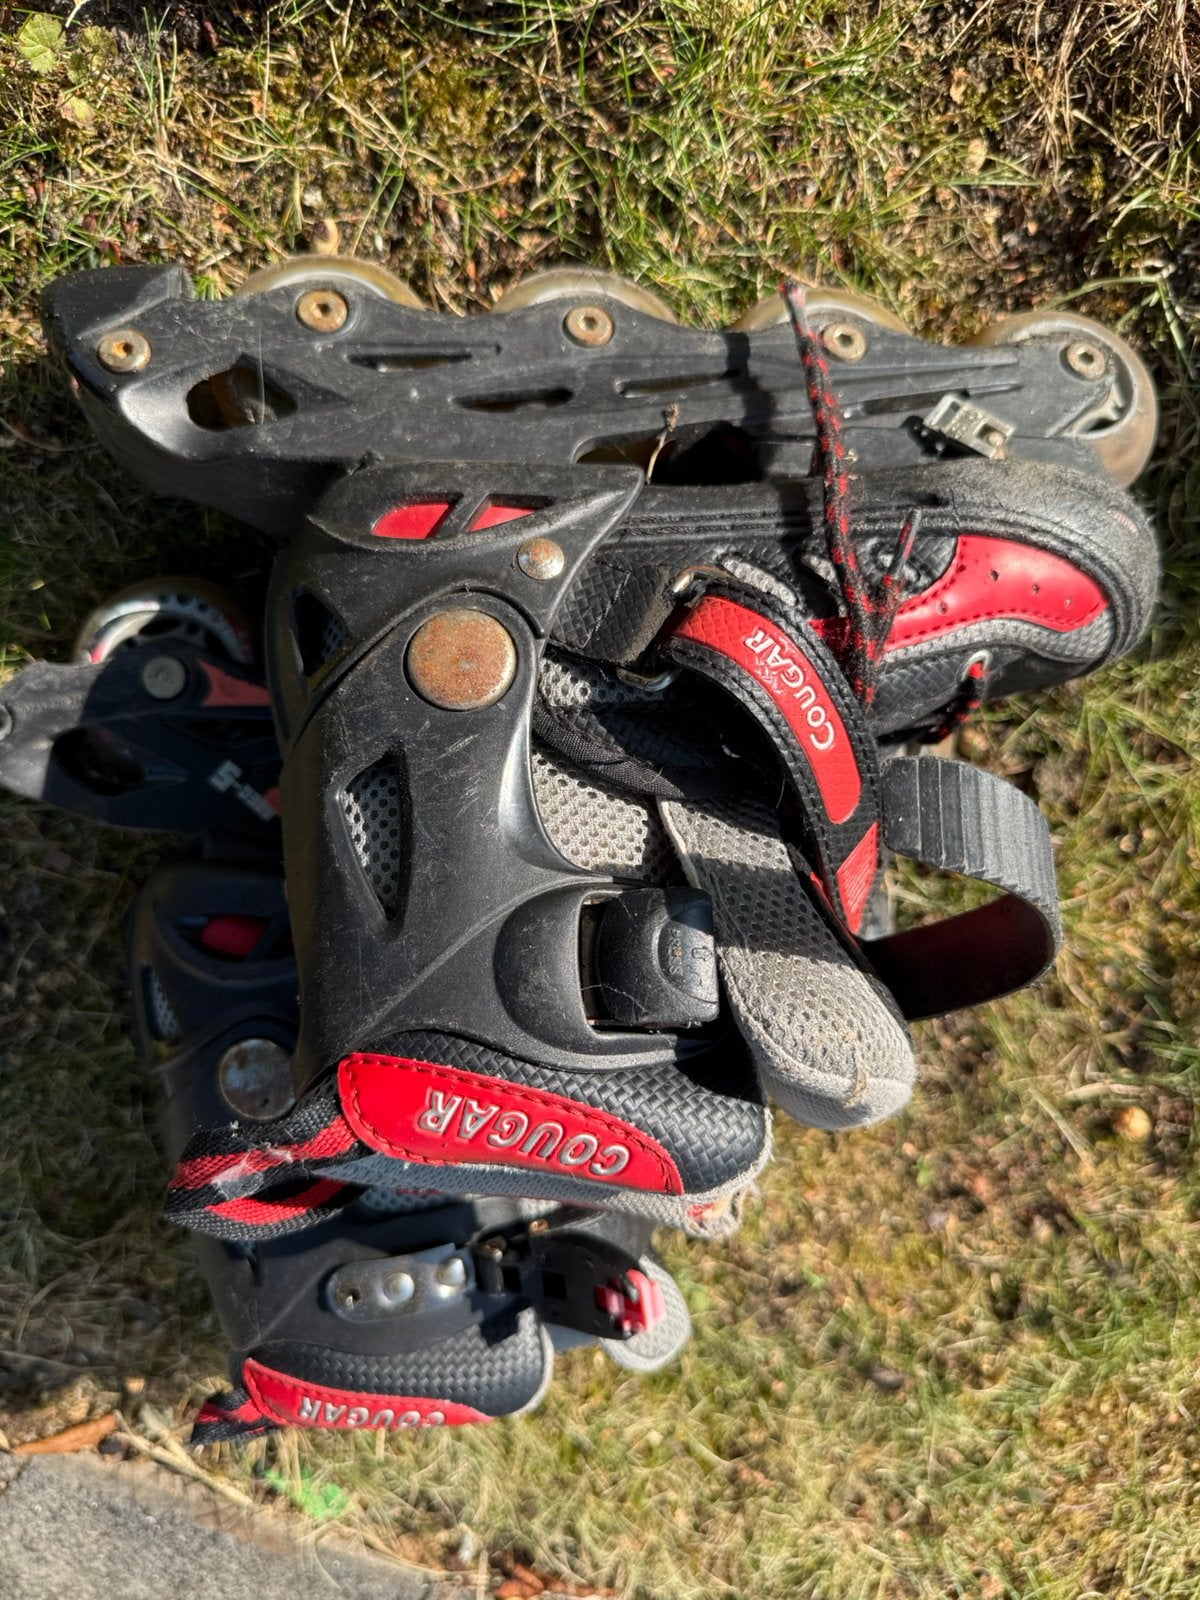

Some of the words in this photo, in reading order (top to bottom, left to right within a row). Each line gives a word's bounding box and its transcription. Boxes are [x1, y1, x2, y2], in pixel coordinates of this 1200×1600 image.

[745, 628, 835, 750] COUGAR
[418, 1089, 630, 1176] COUGAR
[300, 1396, 446, 1428] COUGAR
